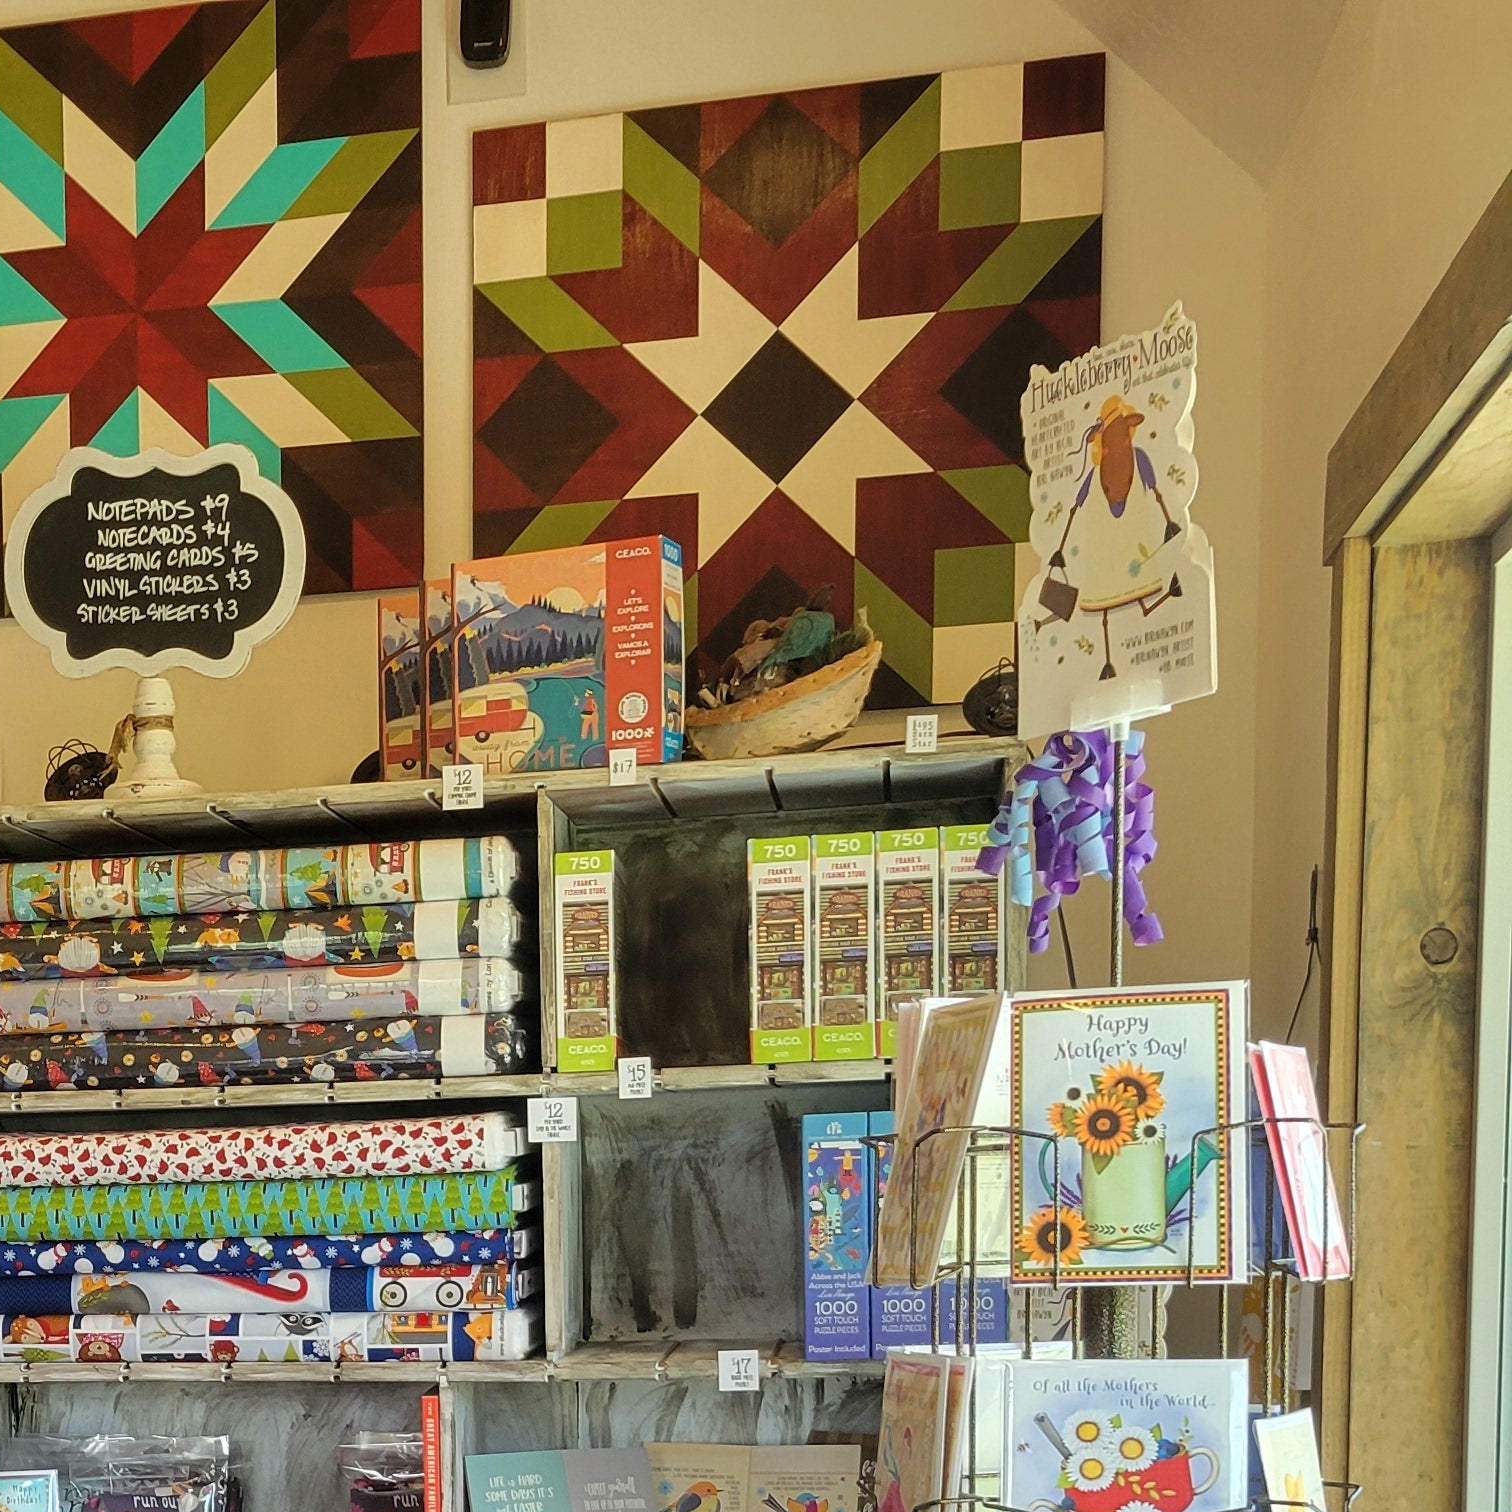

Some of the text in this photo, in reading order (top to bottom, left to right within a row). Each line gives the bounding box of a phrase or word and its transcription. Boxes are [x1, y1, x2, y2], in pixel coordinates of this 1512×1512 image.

[1138, 325, 1193, 369] Moose
[88, 494, 230, 522] NOTEPADS $9
[97, 519, 230, 547] NOTECARDS $4
[85, 540, 258, 571] GREETING CARDS $5
[83, 569, 251, 599] VINYL STICKERS $3
[77, 598, 238, 624] STICKER SHEETS $3
[612, 729, 641, 741] 1000
[613, 760, 633, 773] $17
[454, 769, 472, 785] $12
[892, 832, 924, 846] 750
[764, 844, 796, 859] 750
[570, 857, 600, 870] 750
[768, 868, 793, 876] FRANK'S
[784, 875, 802, 883] STORE
[1087, 1014, 1148, 1034] Happy
[1054, 1037, 1187, 1062] Mother's Day!
[627, 1064, 645, 1081] $15
[811, 1272, 832, 1280] Abbie
[815, 1300, 858, 1315] 1000
[815, 1315, 858, 1324] SOFT TOUCH
[814, 1326, 835, 1334] PUZZLE
[835, 1344, 865, 1352] Included
[732, 1358, 751, 1374] $17
[1033, 1379, 1158, 1397] Of all the Mothers
[1120, 1394, 1133, 1408] in
[1137, 1393, 1158, 1410] the
[490, 1475, 504, 1488] LIFE
[518, 1474, 542, 1487] HARD
